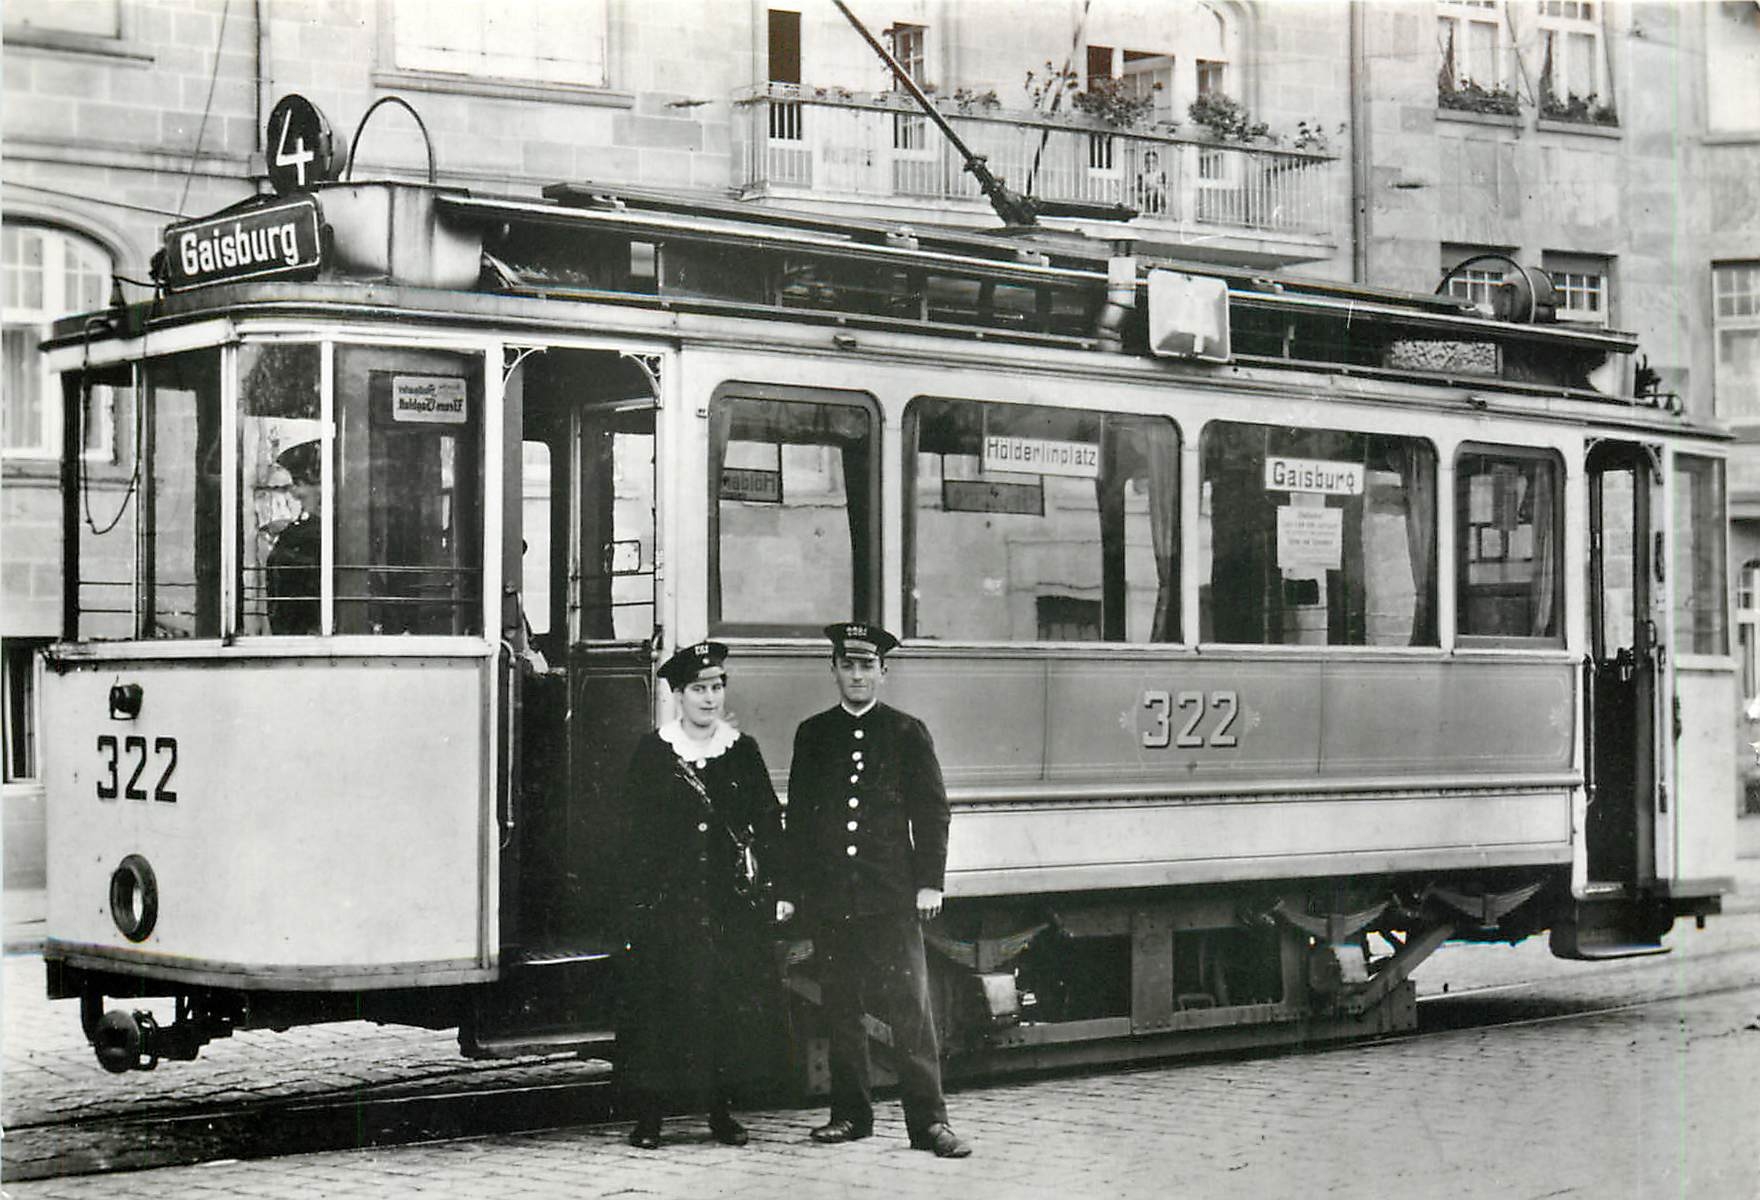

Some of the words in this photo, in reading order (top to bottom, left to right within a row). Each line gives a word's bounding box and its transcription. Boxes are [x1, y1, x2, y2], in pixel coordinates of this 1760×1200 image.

[276, 109, 314, 185] 4
[180, 221, 300, 276] Gaisburg
[986, 438, 1097, 467] Hölderlinplatz
[1272, 460, 1355, 495] Gaisburg
[1142, 690, 1240, 749] 322
[97, 735, 178, 803] 322
